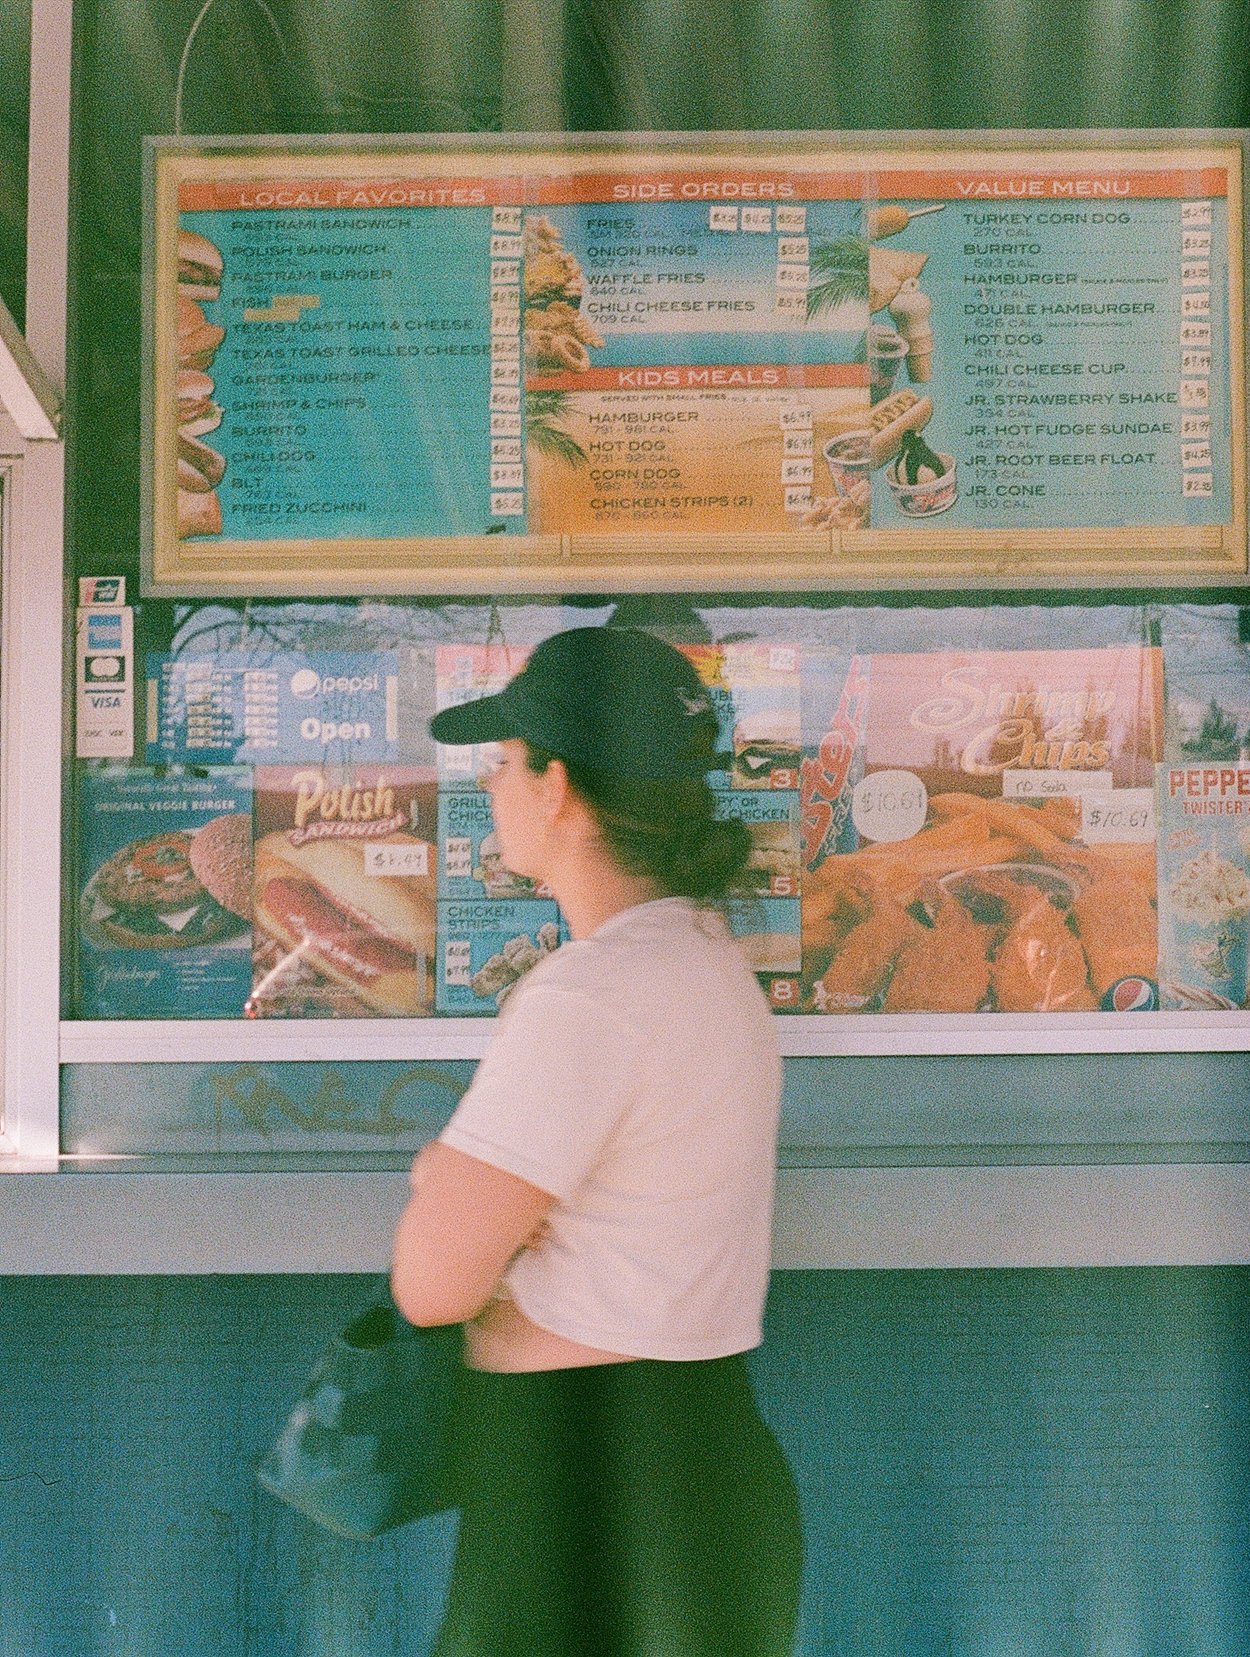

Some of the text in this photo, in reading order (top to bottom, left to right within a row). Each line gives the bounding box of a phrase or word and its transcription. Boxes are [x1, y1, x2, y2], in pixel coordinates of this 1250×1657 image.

[613, 182, 796, 198] SIDE ORDERS
[957, 180, 1131, 196] VALUE MENU
[240, 189, 486, 207] LOCAL FAVORITES
[587, 219, 635, 230] FRIES
[964, 213, 1130, 225] TURKEY CORN DOG
[587, 245, 698, 258] ONION RINGS
[964, 244, 1042, 255] BURRITO
[587, 273, 705, 285] WAFFLE FRIES
[964, 274, 1078, 285] HAMBURGER
[587, 300, 755, 313] CHILI CHEESE FRIES
[964, 303, 1155, 315] DOUBLE HAMBURGER
[964, 334, 1043, 346] HOT DOG
[964, 364, 1126, 376] CHILI CHEESE CUP
[618, 369, 779, 386] KIDS MEALS
[965, 393, 1178, 406] JR. STRAWBERRY SHAKE
[588, 412, 699, 423] HAMBURGER
[965, 423, 1172, 436] JR. HOT FUDGE SUNDAE
[589, 440, 666, 452] HOT DOG
[964, 454, 1155, 466] JR. ROOT BEER FLOAT
[589, 468, 681, 480] CORN DOG
[965, 485, 1046, 497] JR. CONE
[590, 498, 667, 509] CHICKEN
[673, 497, 729, 508] STRIPS
[322, 674, 378, 694] pepsi
[91, 697, 121, 709] VISA
[301, 719, 372, 743] Open
[962, 718, 1112, 775] Chips
[774, 768, 792, 787] 3
[150, 801, 188, 810] VEGGIE
[192, 800, 235, 810] BURGER
[292, 770, 397, 828] Polish
[1183, 800, 1243, 815] TWISTER
[728, 809, 790, 820] CHICKEN
[1087, 809, 1149, 829] $10.69
[774, 877, 792, 896] 5
[447, 906, 515, 918] CHICKEN
[448, 920, 500, 930] STRIPS
[774, 983, 792, 1001] 8
